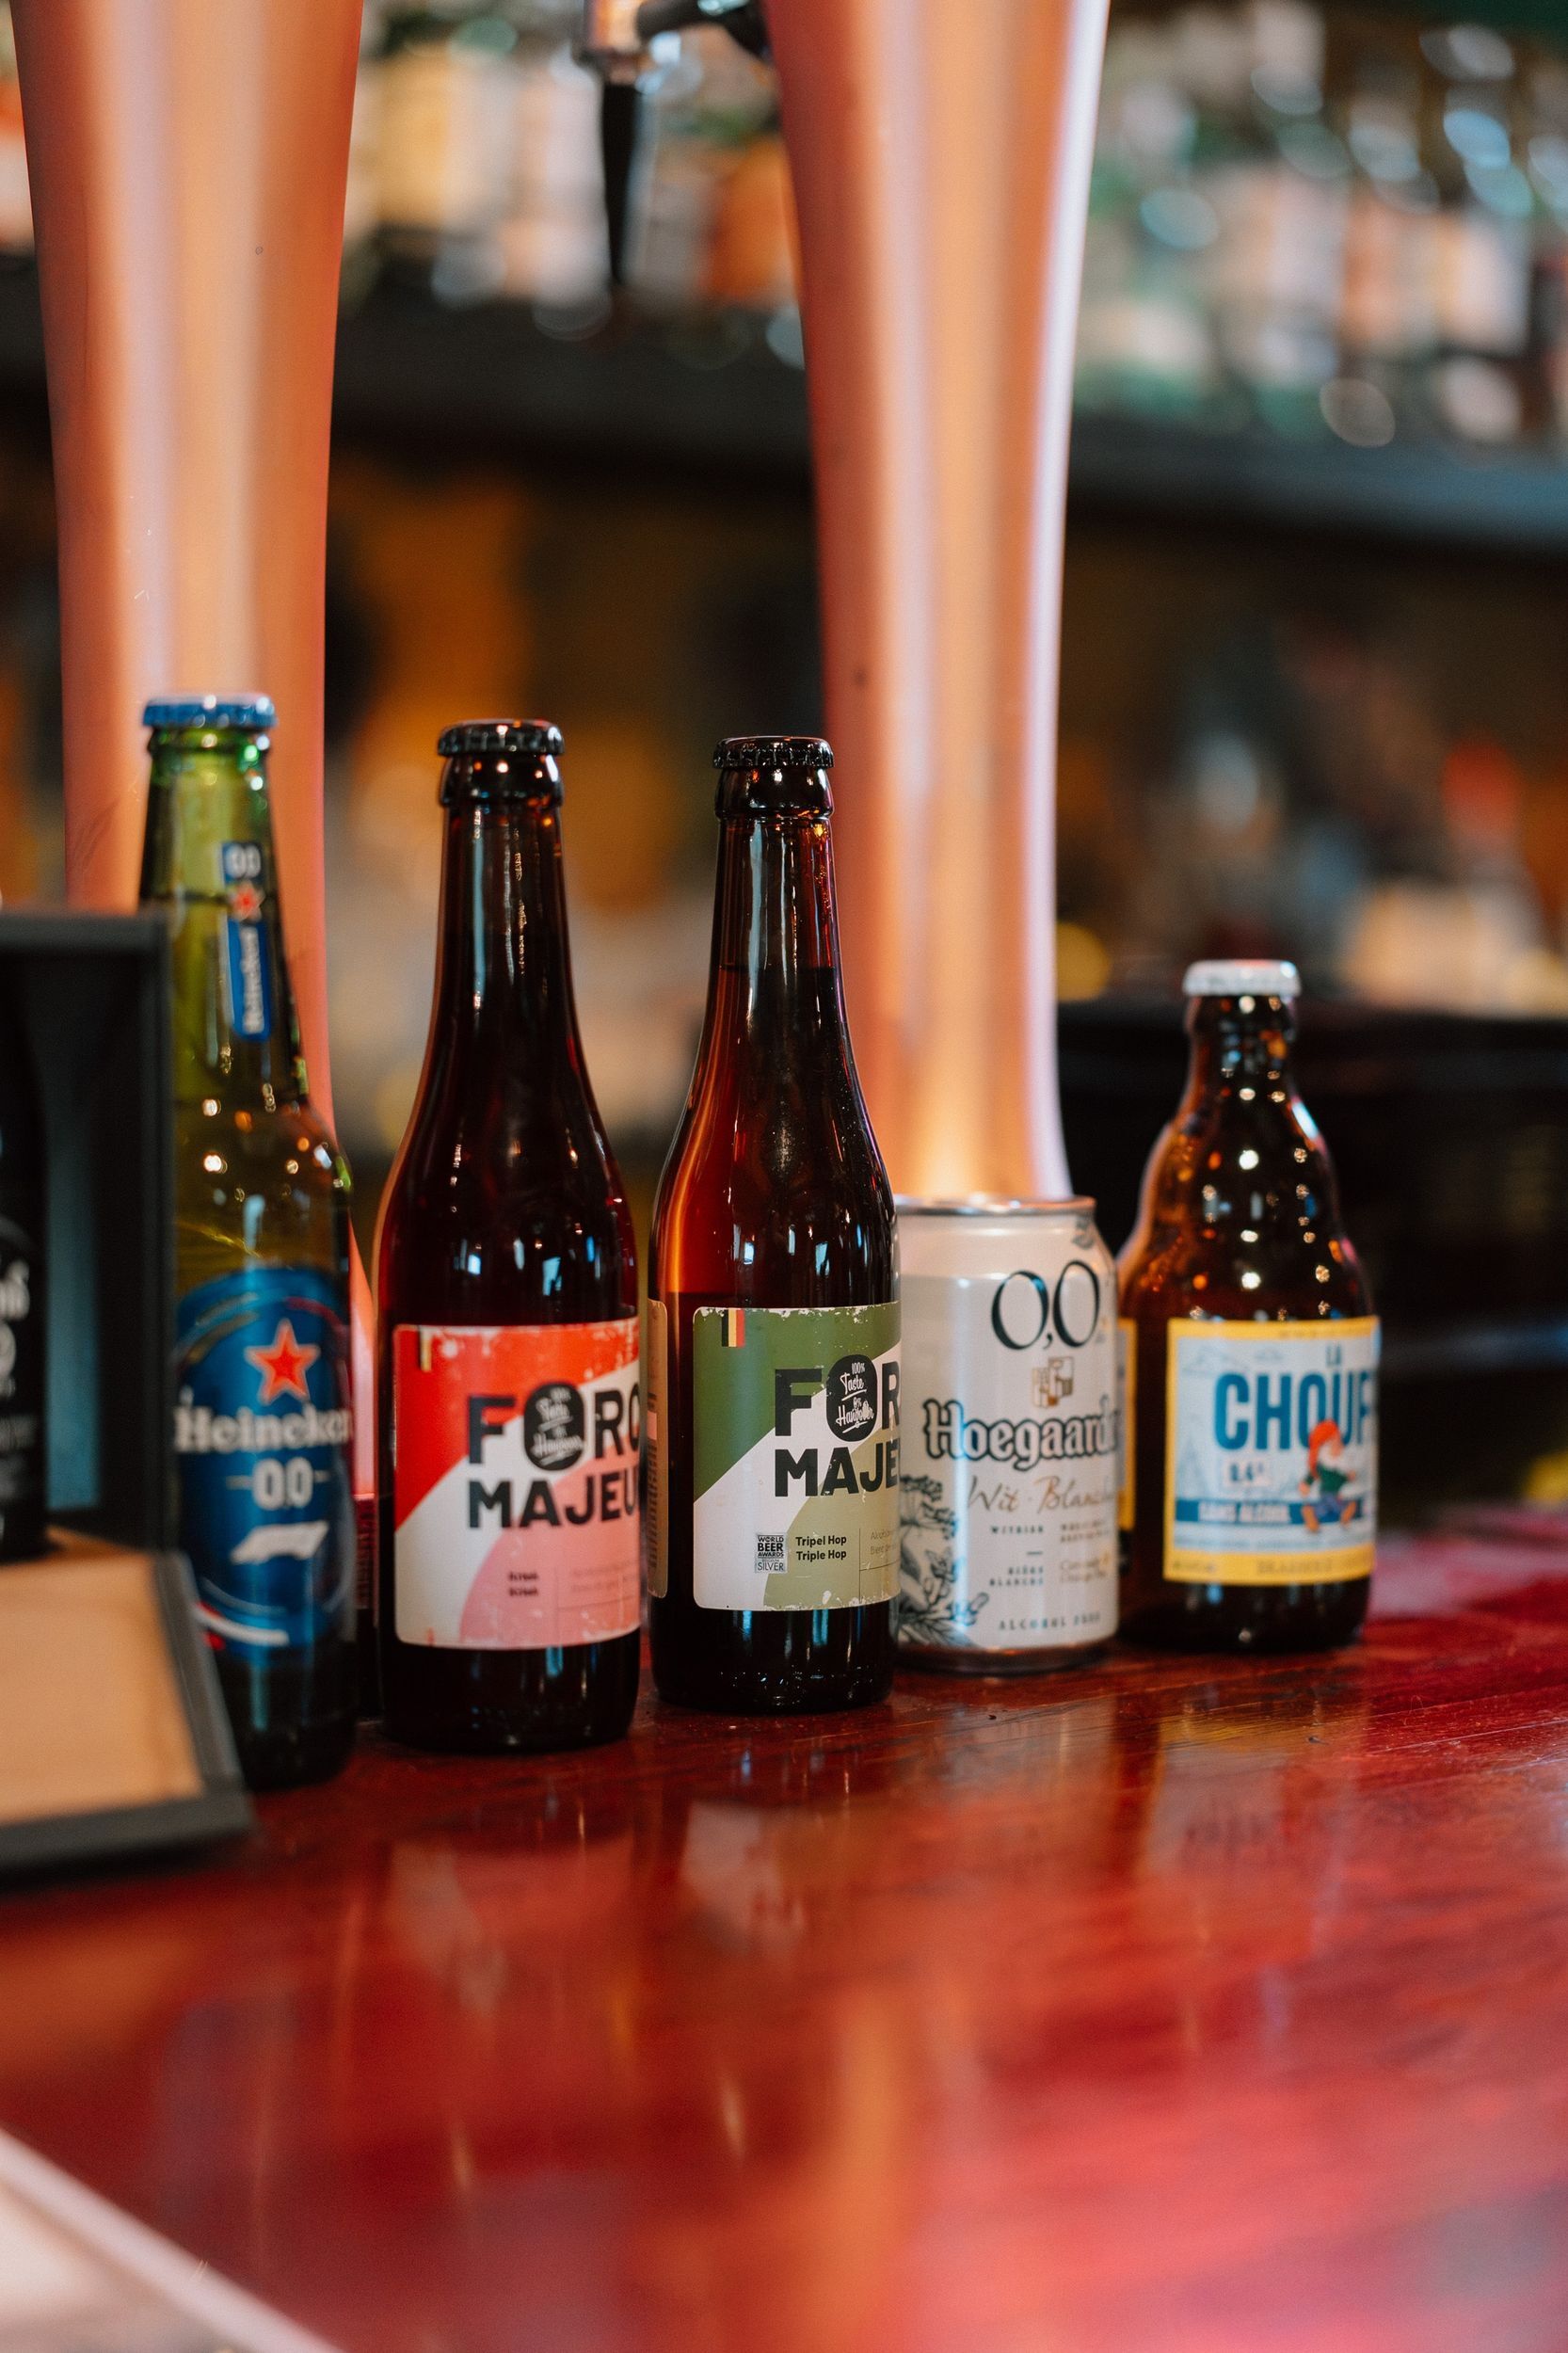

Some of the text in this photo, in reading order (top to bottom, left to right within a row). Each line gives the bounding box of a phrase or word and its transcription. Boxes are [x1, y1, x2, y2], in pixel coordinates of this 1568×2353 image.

[991, 1259, 1099, 1351] 0,0
[840, 1372, 865, 1395] Taste
[757, 1543, 783, 1552] BEER
[795, 1535, 847, 1548] Tripel Hop
[795, 1549, 847, 1562] Triple Hop
[757, 1562, 784, 1571] SILVER
